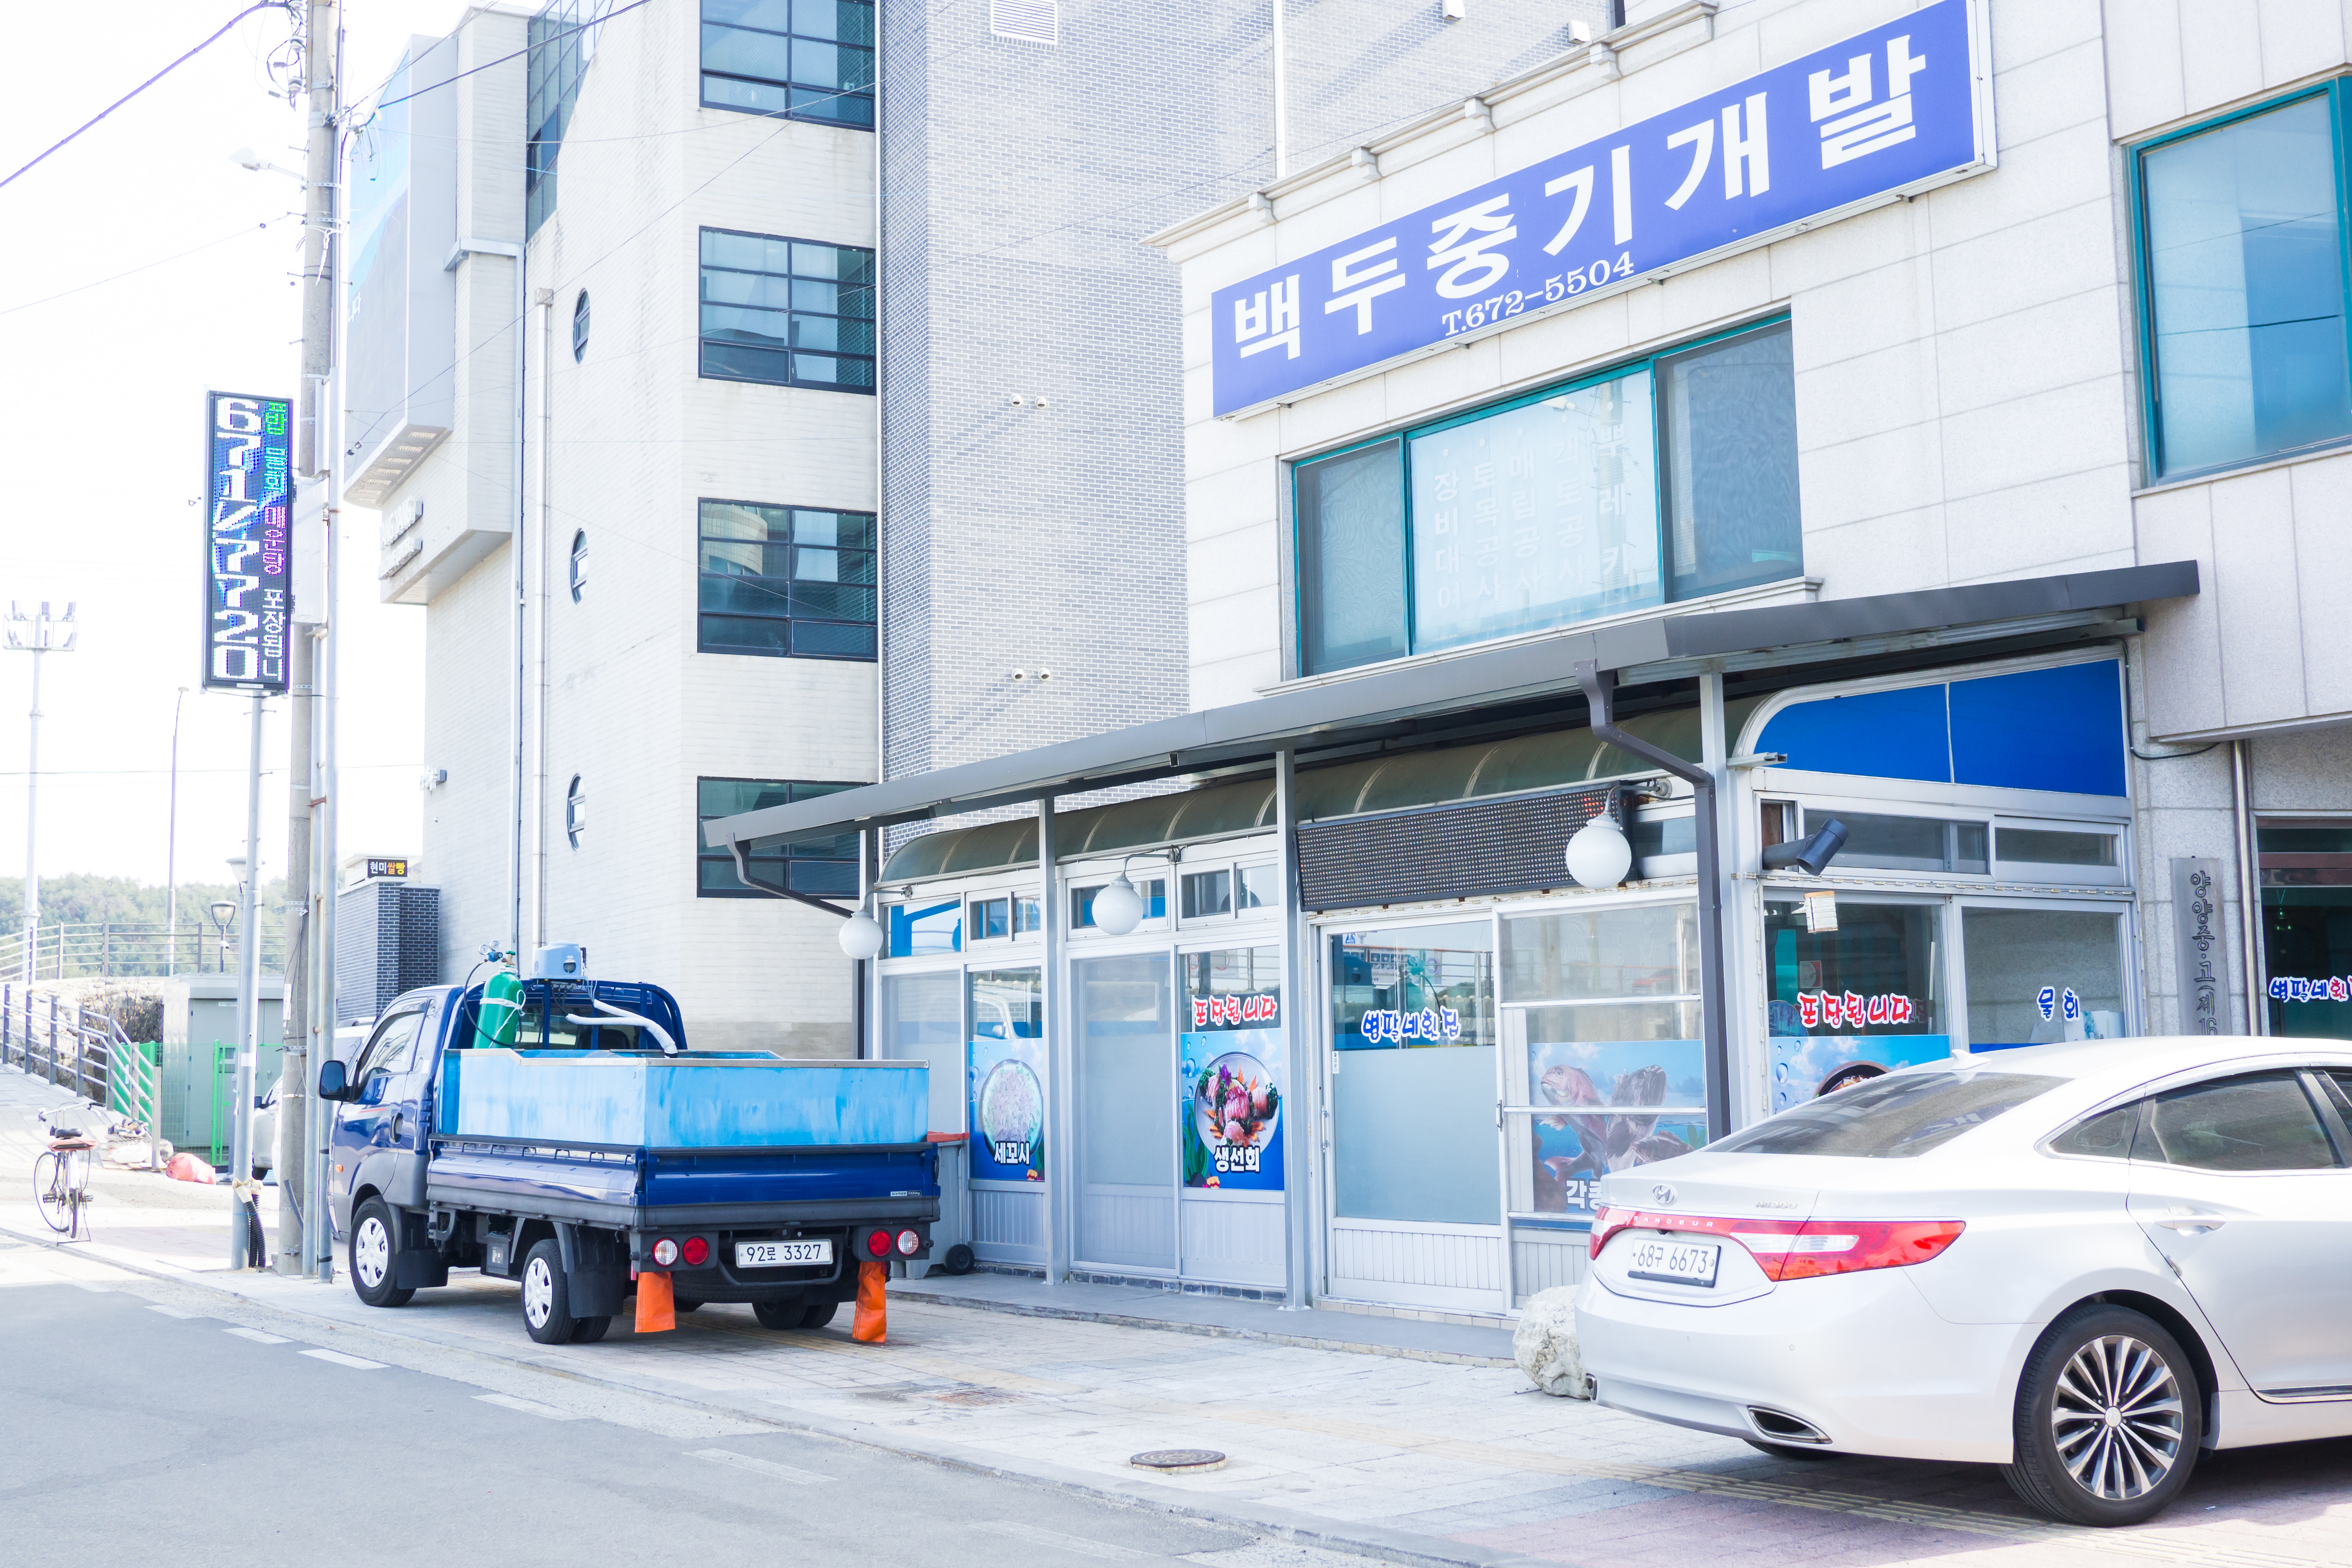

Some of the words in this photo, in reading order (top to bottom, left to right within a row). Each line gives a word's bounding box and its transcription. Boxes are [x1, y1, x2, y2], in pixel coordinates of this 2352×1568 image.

[1234, 33, 1927, 360] 백두중기개발
[1442, 251, 1635, 337] T.672-5504
[1509, 450, 1541, 595] 매립공사
[1555, 435, 1587, 585] 객토공사
[263, 507, 286, 575] 매운탕
[1433, 469, 1461, 612] 장비대여
[1472, 460, 1503, 603] 토목공사
[370, 861, 405, 875] 현미쌀빵
[2268, 975, 2352, 1002] 병팔네횟
[1194, 994, 1277, 1025] 포장됩니다
[1798, 990, 1912, 1028] 포장됩니다
[994, 1141, 1031, 1166] 세꼬시
[1214, 1145, 1261, 1174] 생선회
[1755, 1201, 1797, 1209] HG300
[1624, 1215, 1713, 1228] GRANDEUR
[746, 1246, 776, 1263] 92로
[783, 1243, 822, 1260] 3327
[1638, 1244, 1664, 1267] 68구
[1670, 1247, 1709, 1273] 6673
